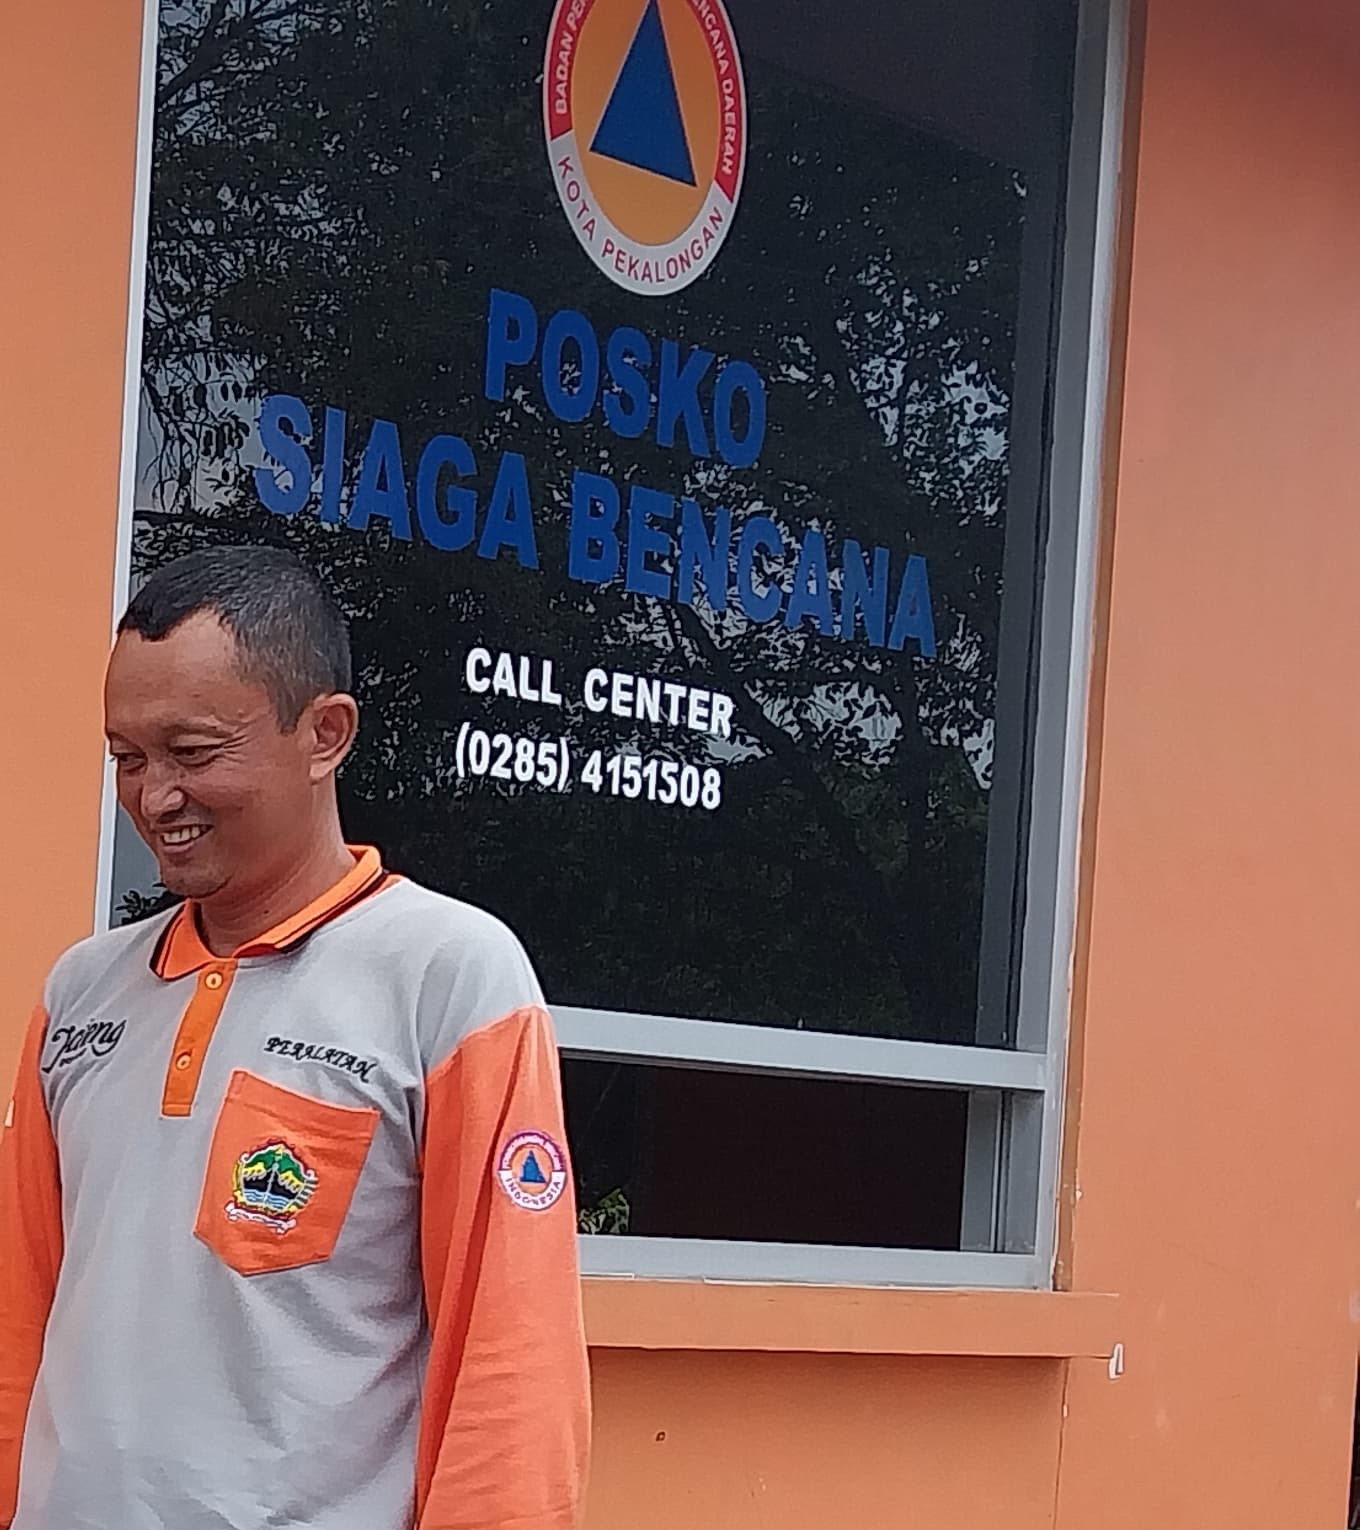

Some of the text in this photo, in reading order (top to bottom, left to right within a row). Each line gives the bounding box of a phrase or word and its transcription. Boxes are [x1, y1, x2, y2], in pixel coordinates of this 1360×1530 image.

[555, 30, 573, 114] BADAN
[691, 0, 738, 174] NCANA DAERAH
[557, 155, 724, 284] KOTA PEKALONGAN
[484, 288, 767, 468] POSKO
[253, 393, 937, 658] SIAGA BENCANA
[465, 646, 735, 739] CALL CENTER
[455, 721, 722, 810] (0285) 4151508
